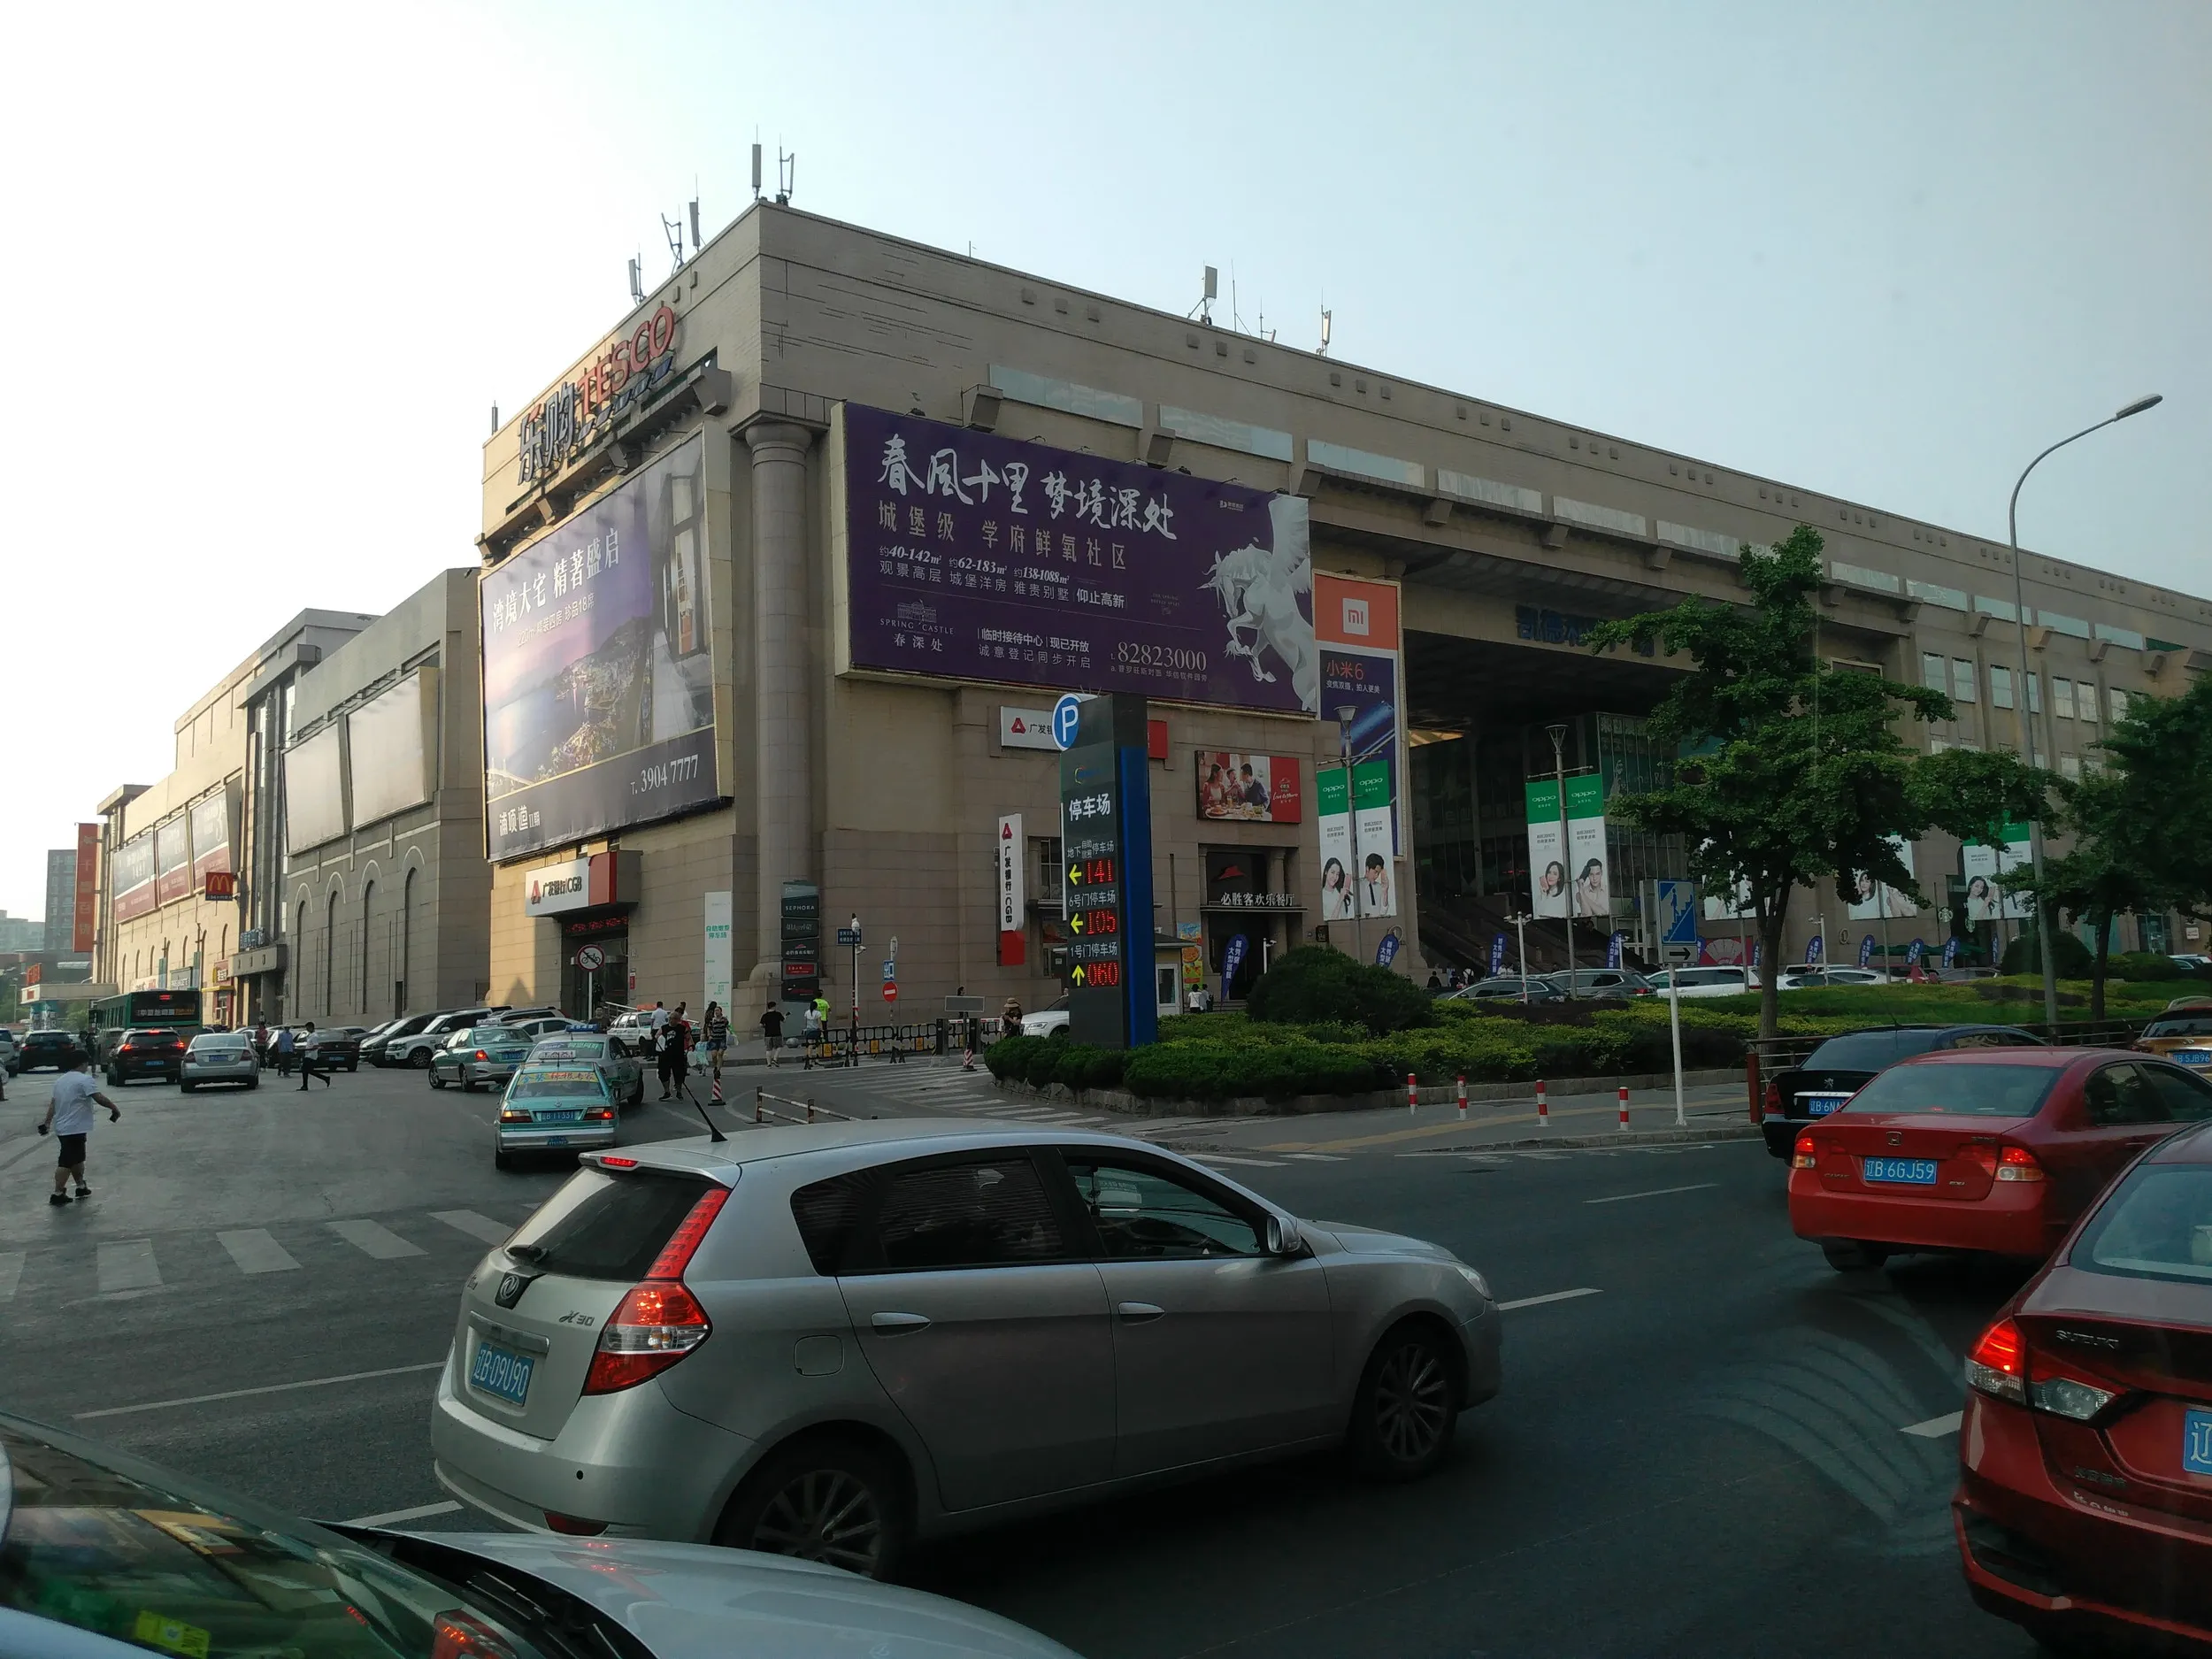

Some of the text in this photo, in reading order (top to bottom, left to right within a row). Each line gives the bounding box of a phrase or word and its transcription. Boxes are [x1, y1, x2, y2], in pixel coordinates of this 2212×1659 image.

[577, 305, 675, 416] TESCO
[878, 433, 1178, 540] 春风十里 梦境深处
[878, 499, 1127, 572] 城堡级 学府鲜氧社区
[879, 559, 942, 584] 观景高层
[949, 571, 1007, 594] 城堡洋房
[1014, 580, 1070, 603] 雅贵别墅
[879, 618, 955, 635] SPRING CASTLE
[893, 633, 944, 652] 春深处
[980, 627, 1090, 653] 临时接待中心 现已开放
[978, 643, 1091, 669] 诚意登记同步开启
[1118, 641, 1207, 672] 82823000
[1326, 659, 1364, 680] 小米6
[1062, 705, 1079, 742] P
[640, 763, 668, 794] 3904
[670, 754, 699, 785] 7777
[1069, 793, 1111, 822] 停车场
[1093, 841, 1115, 855] 停车场
[567, 875, 582, 893] CGB
[1087, 859, 1112, 884] 141
[1069, 890, 1116, 908] 6号门停车场
[1220, 892, 1295, 907] 必胜客欢乐餐厅
[1087, 910, 1116, 934] 105
[1070, 941, 1118, 958] 1号门停车场
[1087, 963, 1119, 987] 060
